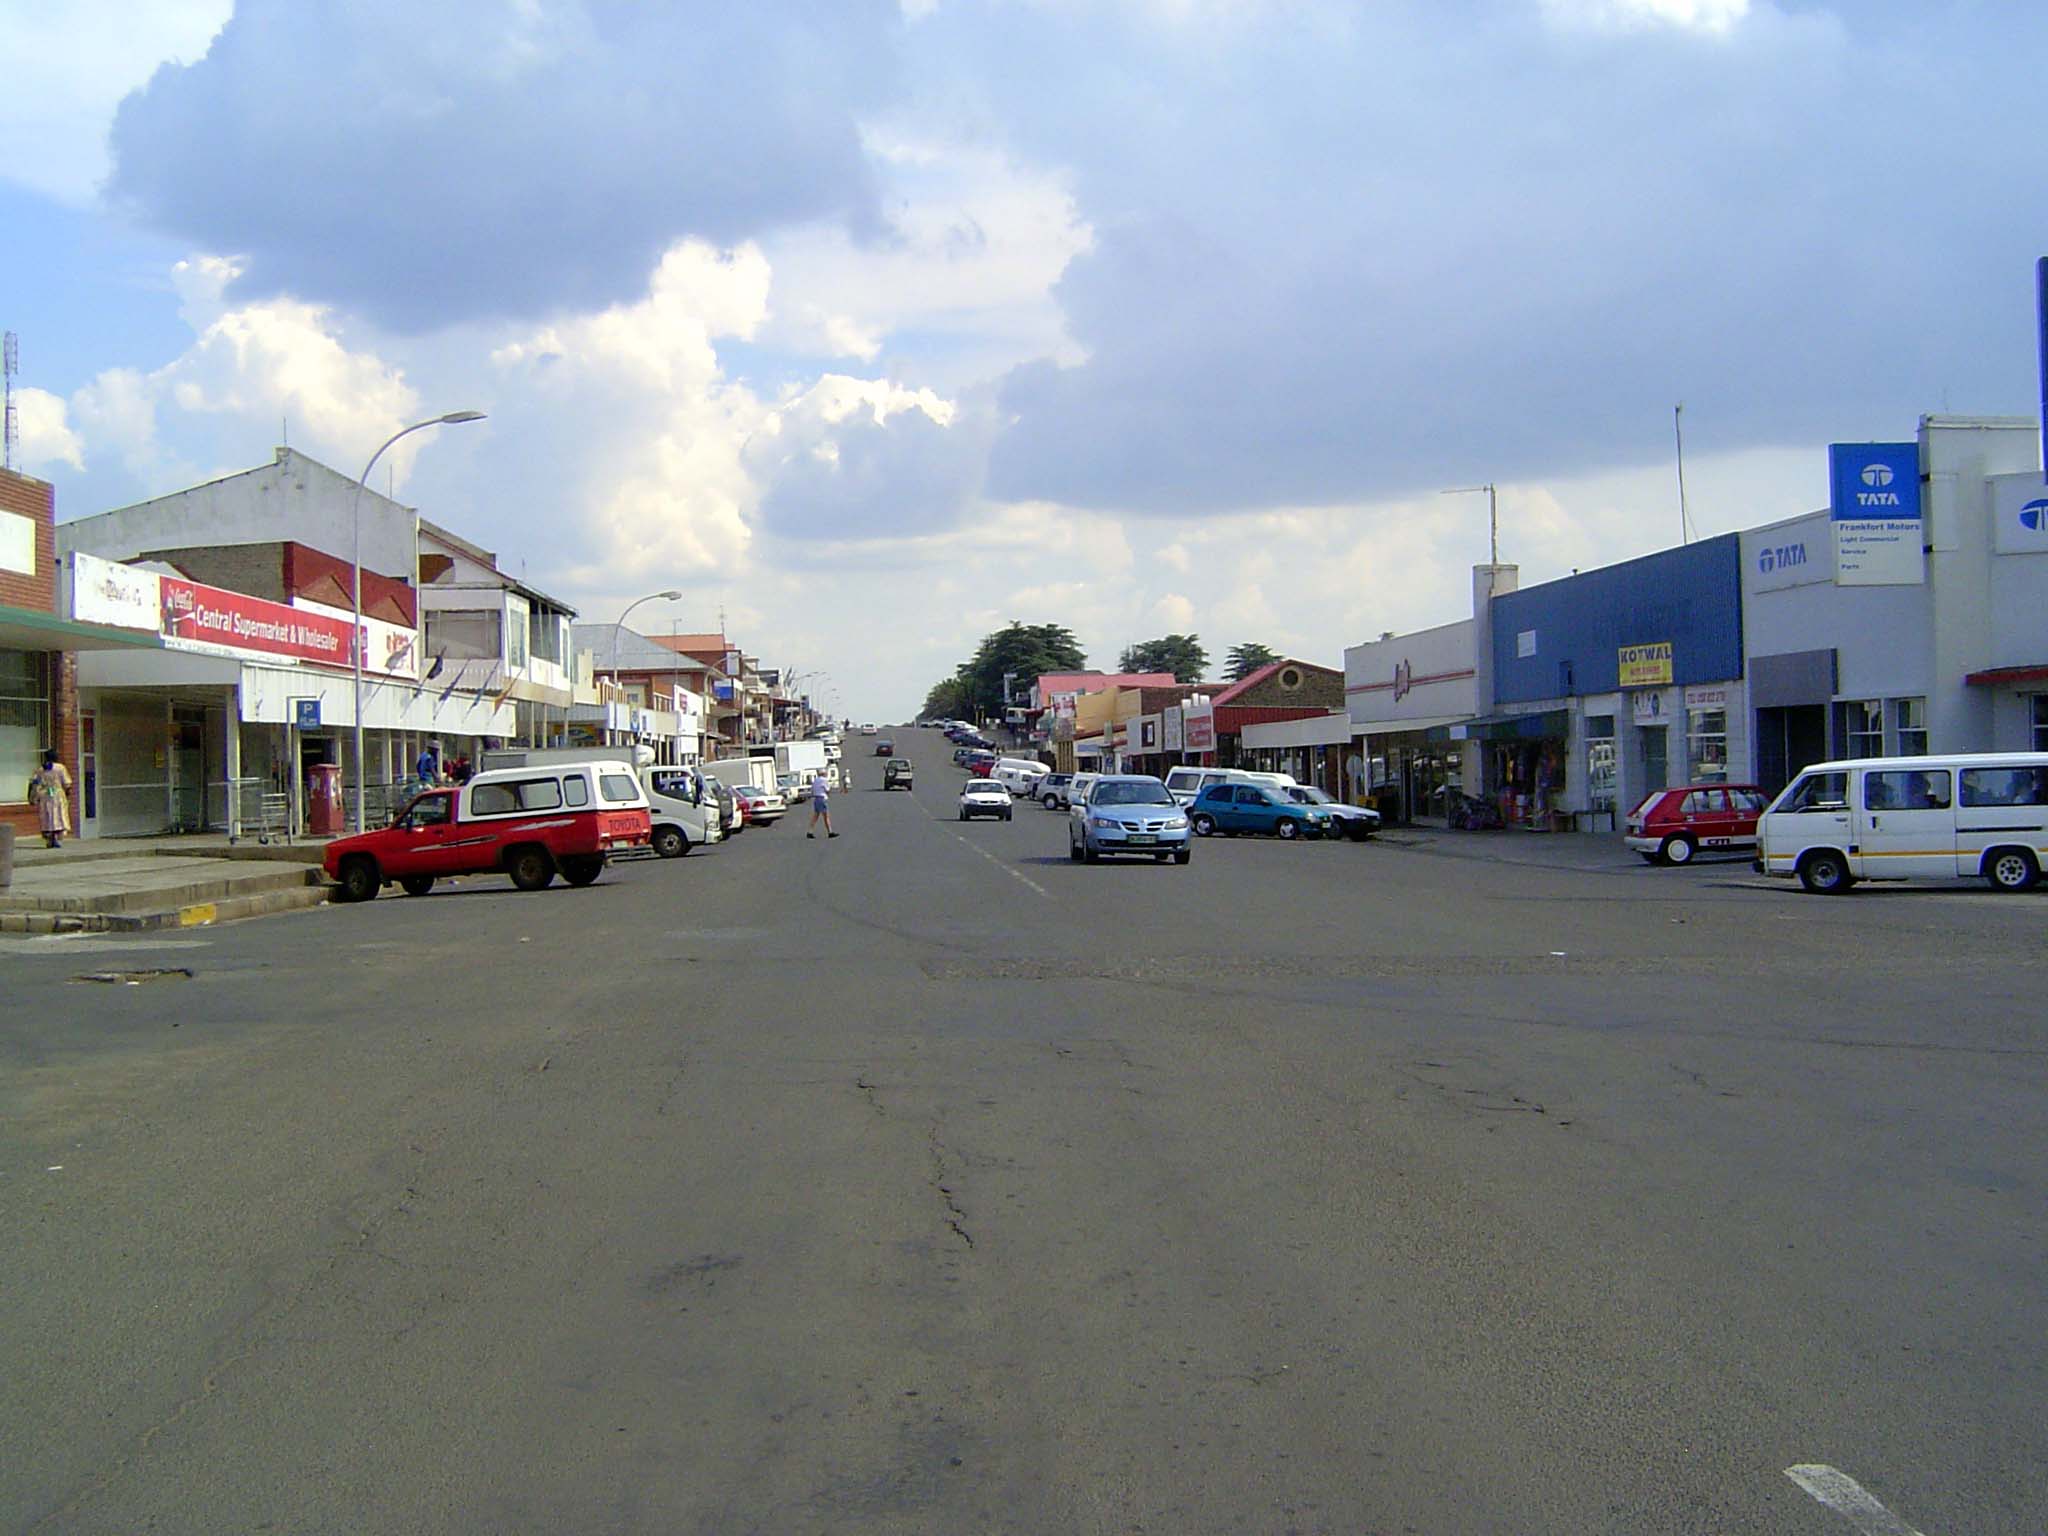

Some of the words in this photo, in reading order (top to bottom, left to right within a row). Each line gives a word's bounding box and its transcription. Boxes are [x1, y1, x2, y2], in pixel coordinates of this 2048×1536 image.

[1857, 493, 1900, 506] TATA
[1839, 523, 1884, 531] Frankfort
[1887, 523, 1921, 531] Motors
[1775, 543, 1807, 568] TATA
[196, 604, 233, 633] Central
[233, 612, 289, 642] Supermarket
[289, 624, 297, 643] &
[297, 625, 339, 652] Wholesaler
[1620, 646, 1672, 664] KOTWAL
[303, 703, 313, 714] P
[608, 817, 641, 832] TOYOTA
